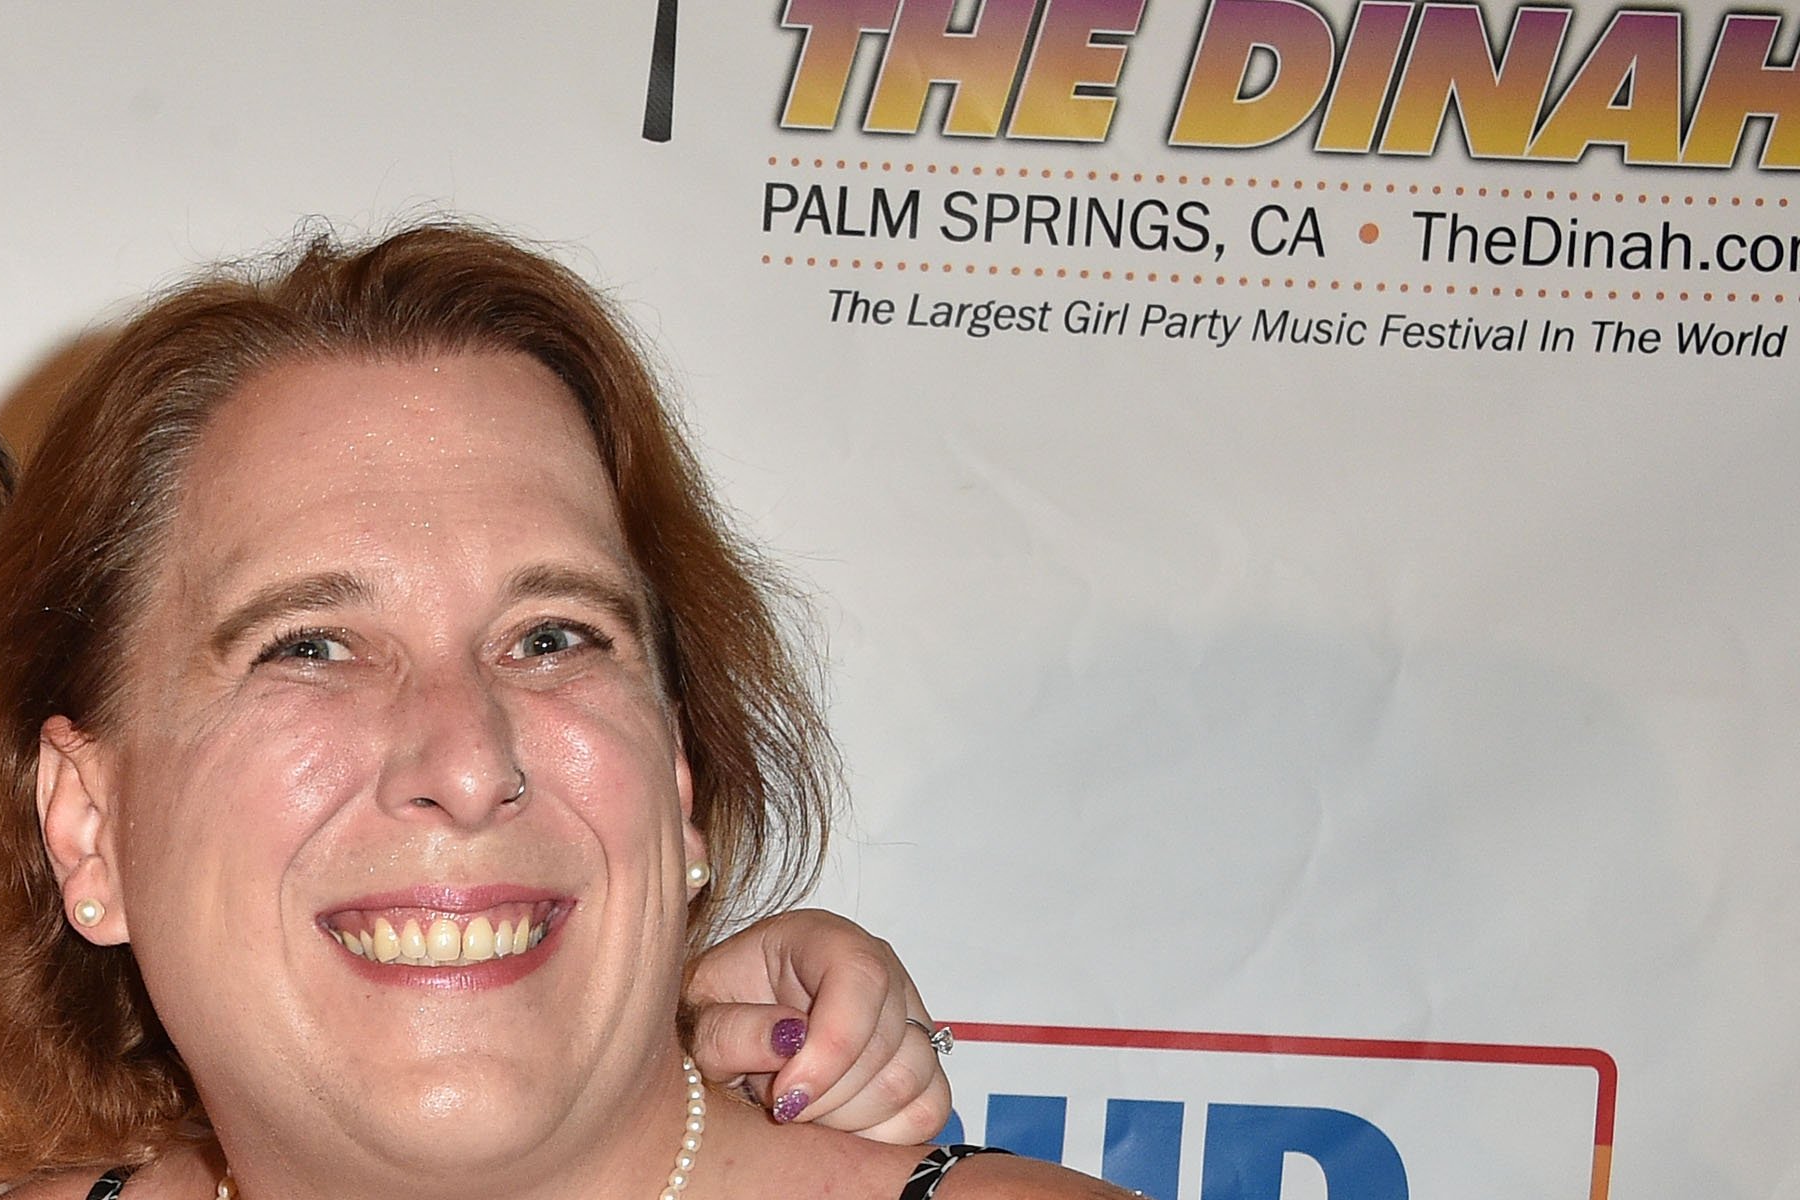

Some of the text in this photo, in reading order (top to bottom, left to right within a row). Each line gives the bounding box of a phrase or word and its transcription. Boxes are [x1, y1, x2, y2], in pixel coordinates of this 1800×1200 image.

[779, 0, 1800, 170] THE DINAH
[762, 182, 1800, 274] PALM SPRINGS, CA TheDinah.co
[828, 289, 1790, 358] The Largest Girl Party Music Festival In The World
